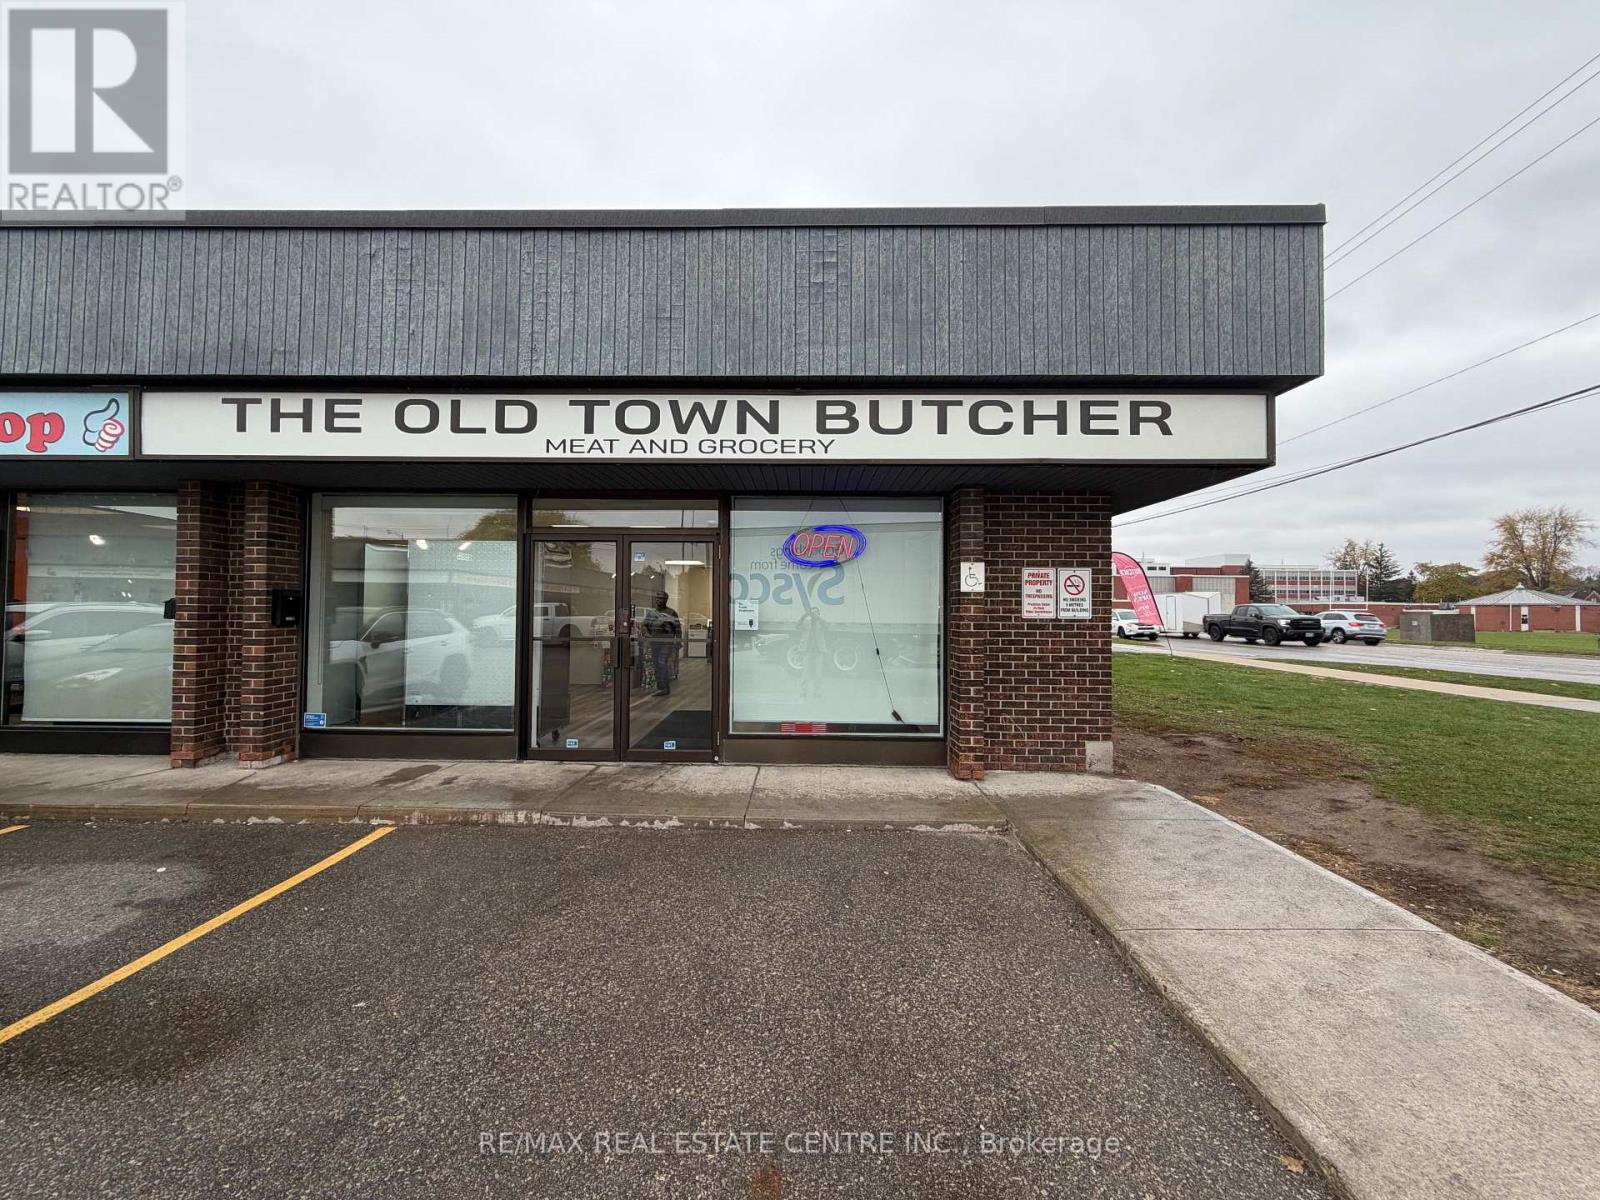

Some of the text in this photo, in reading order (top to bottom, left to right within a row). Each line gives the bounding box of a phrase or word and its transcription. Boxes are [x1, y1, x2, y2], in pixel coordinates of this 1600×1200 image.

[221, 397, 1174, 436] THE OLD TOWN BUTCHER
[545, 438, 836, 455] MEAT AND GROCERY
[793, 532, 854, 560] OPEN
